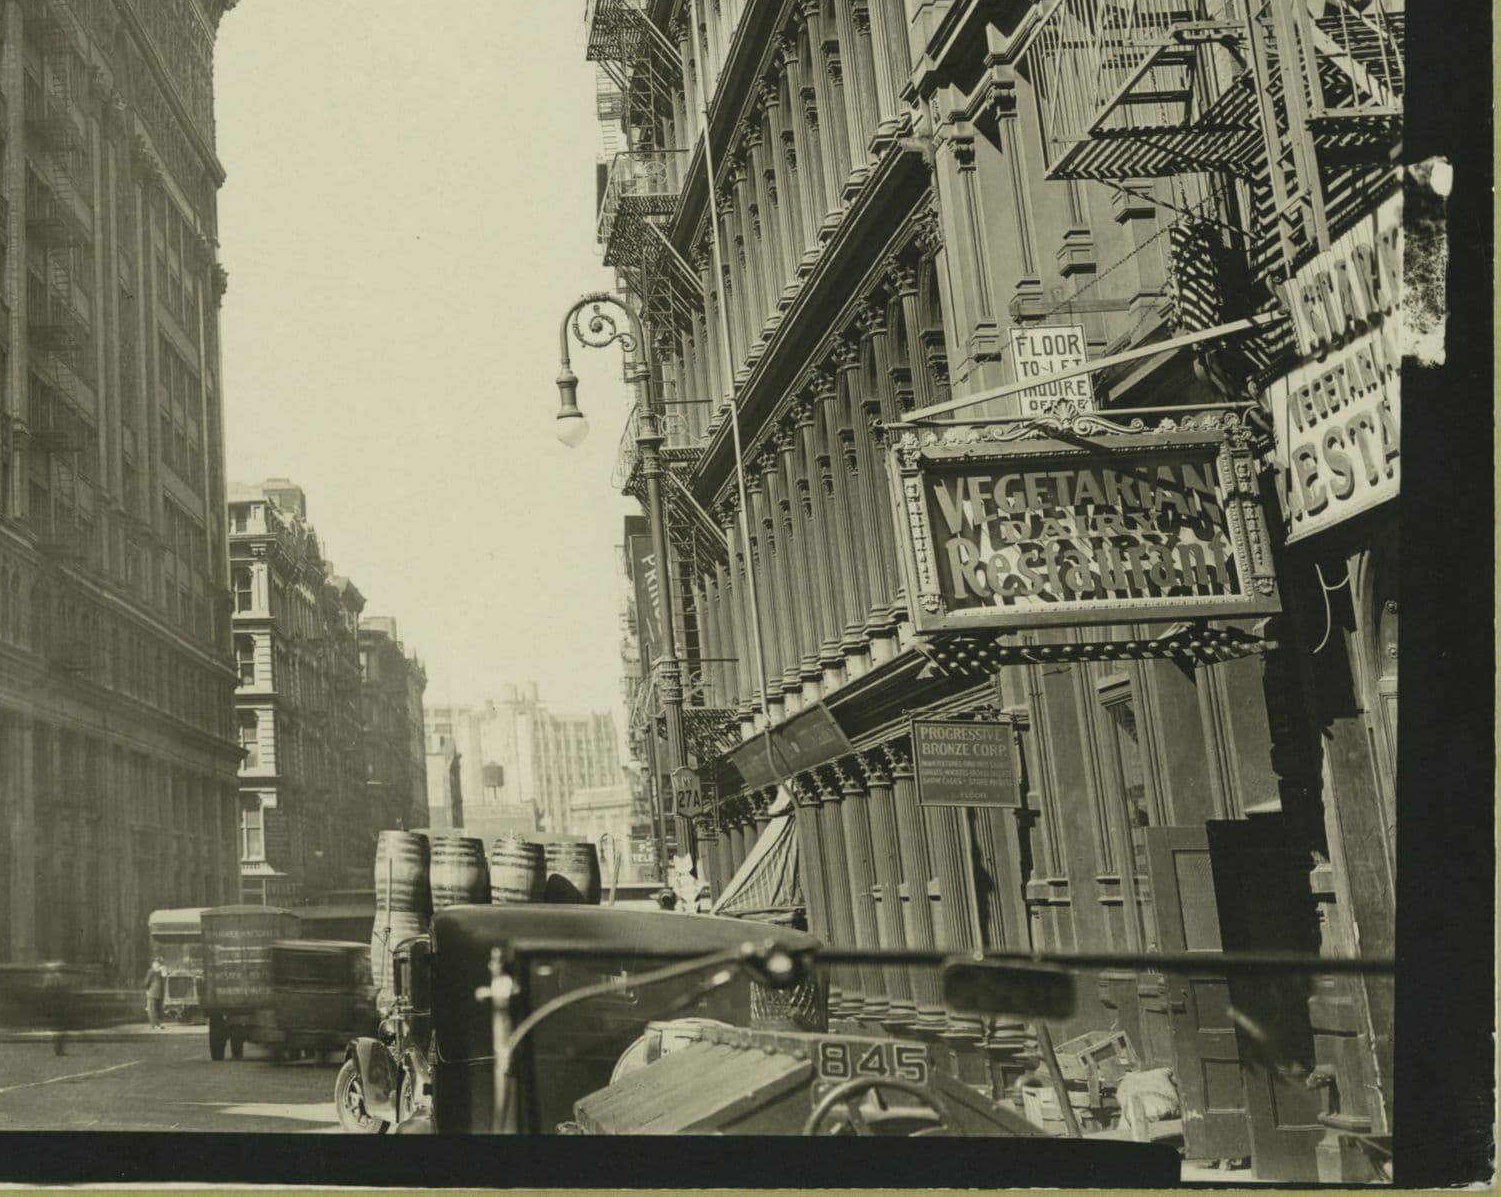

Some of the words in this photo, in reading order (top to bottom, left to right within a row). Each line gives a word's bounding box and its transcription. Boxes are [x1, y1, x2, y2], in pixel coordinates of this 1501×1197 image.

[1015, 334, 1083, 358] FLOOR
[933, 462, 1224, 534] VEGETARIAN
[998, 511, 1163, 544] DAIRY
[945, 530, 1231, 600] Restaurant
[919, 726, 1006, 742] PROGRESSIVE
[921, 742, 971, 756] BRONZE
[972, 743, 1008, 758] CORP.
[677, 789, 701, 808] 27A
[817, 1041, 929, 1083] 845
